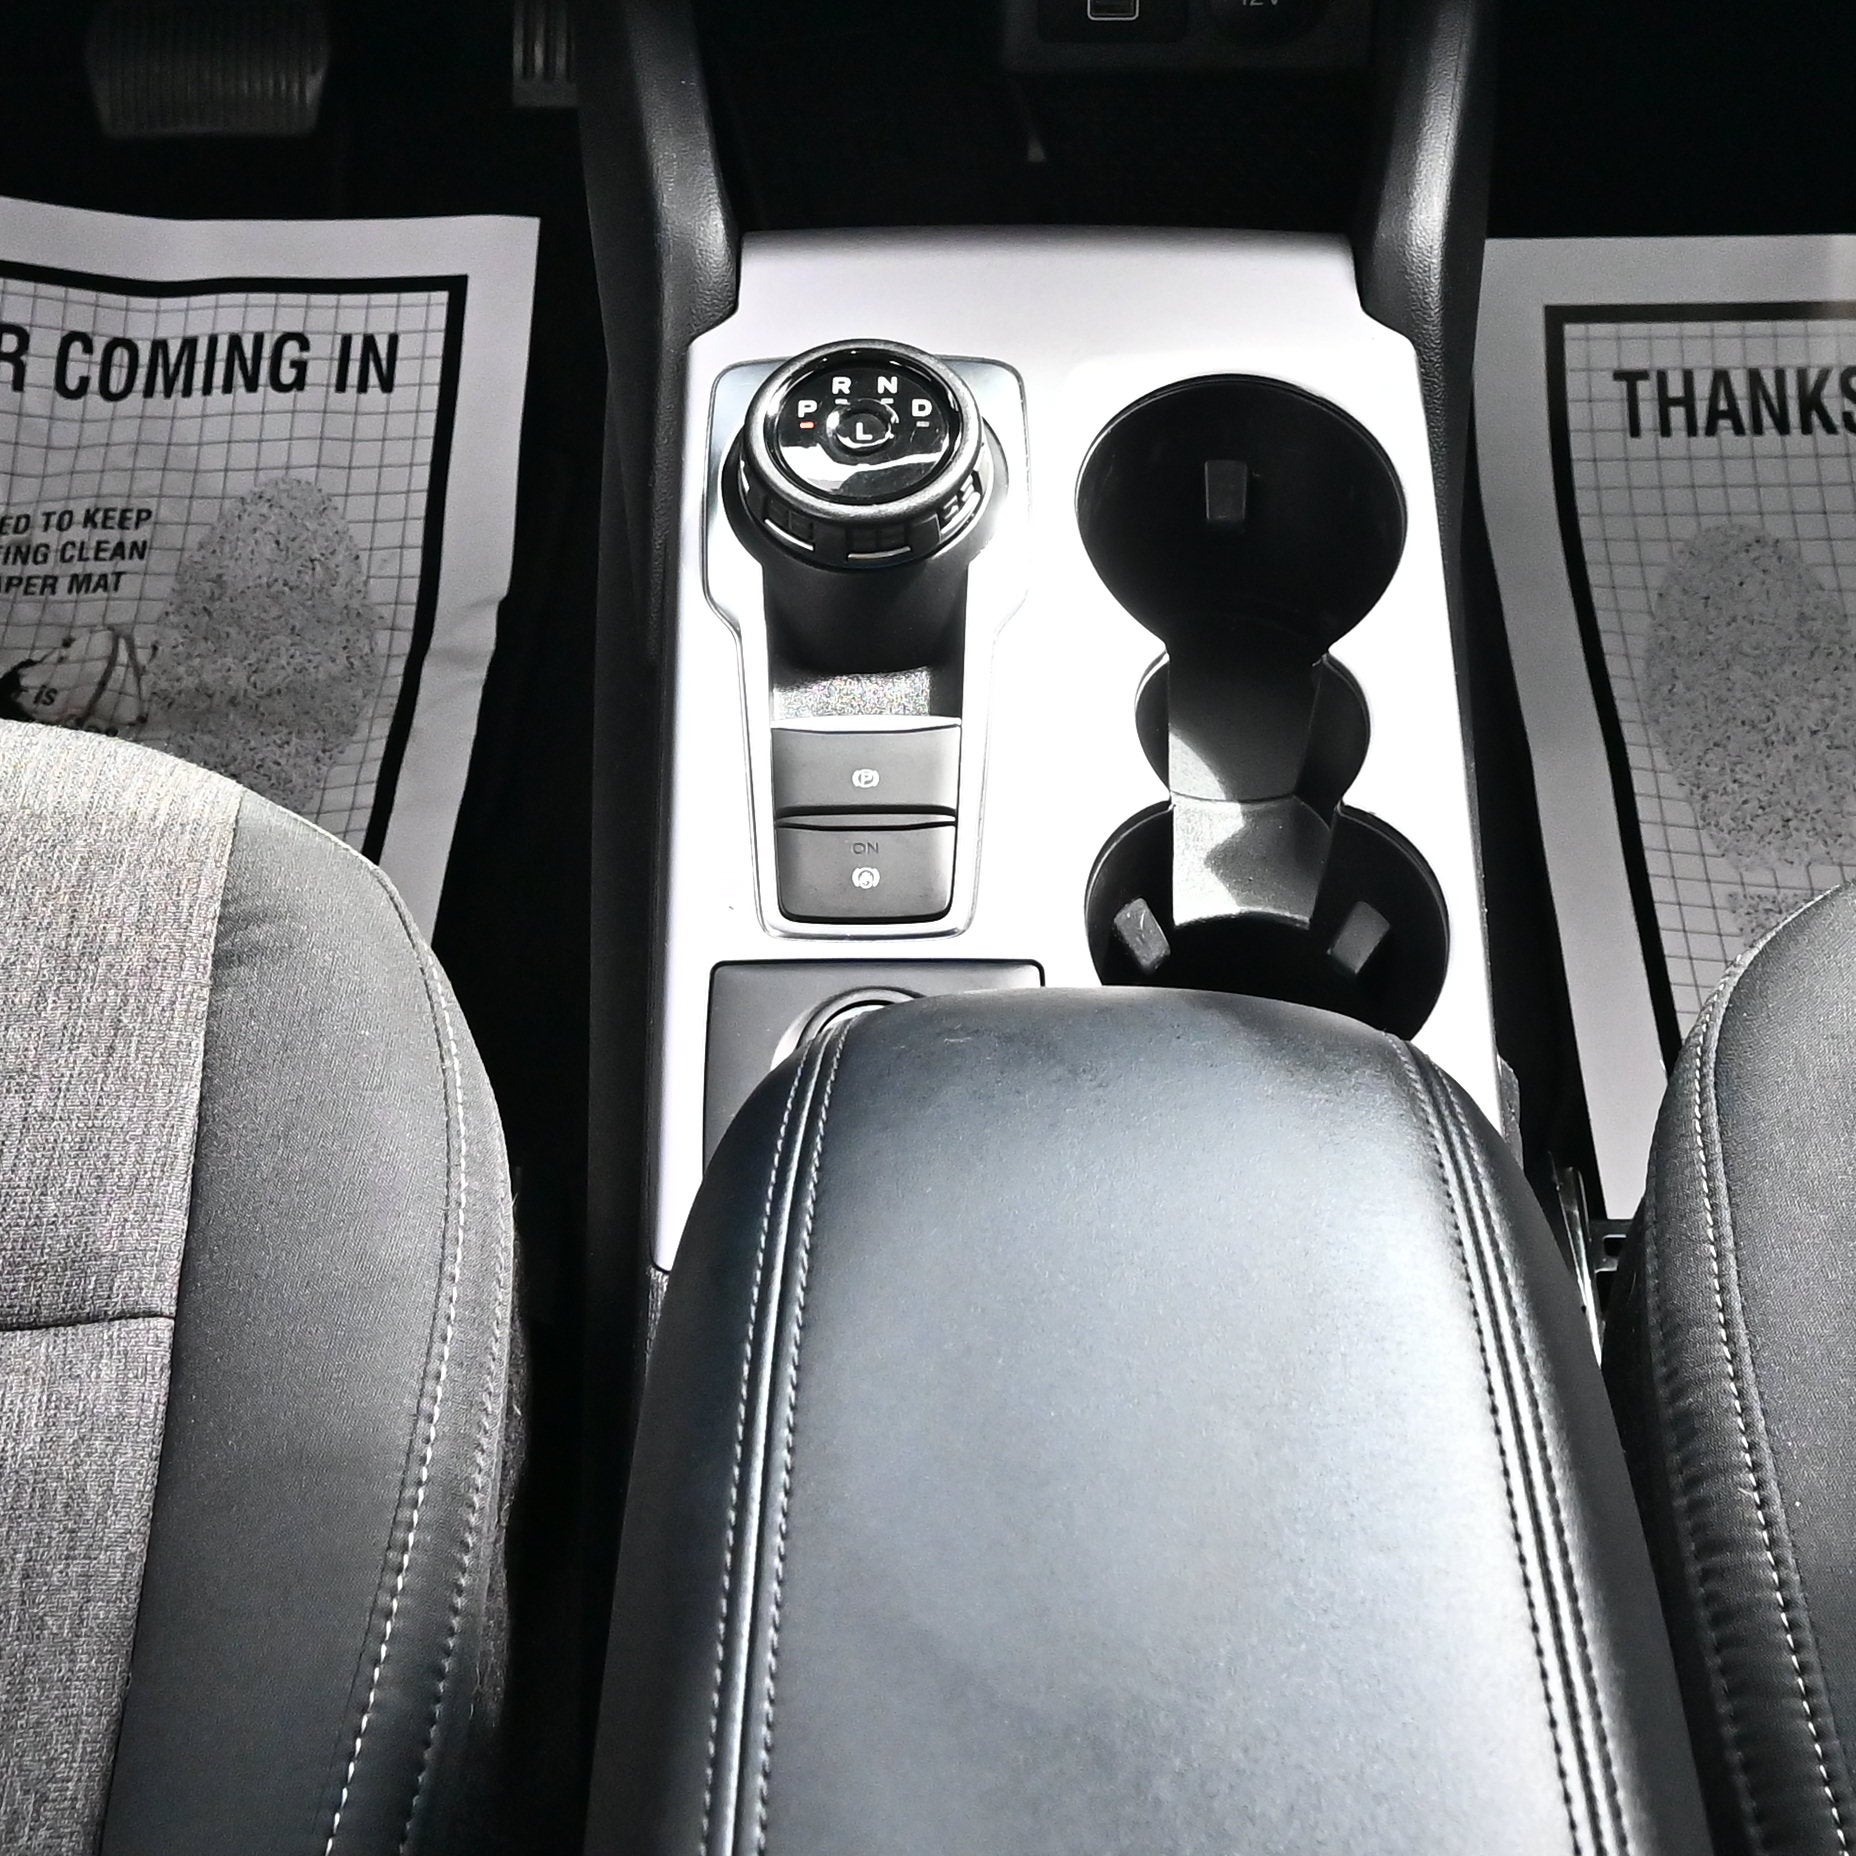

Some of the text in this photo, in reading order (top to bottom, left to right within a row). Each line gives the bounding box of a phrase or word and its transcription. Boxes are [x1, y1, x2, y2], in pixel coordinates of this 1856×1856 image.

[54, 328, 311, 404] COMING
[333, 332, 401, 395] IN
[831, 375, 852, 395] R
[877, 375, 898, 394] N
[797, 399, 818, 418] P
[911, 398, 933, 417] D
[855, 421, 873, 441] L
[41, 508, 74, 533] TO
[81, 507, 153, 532] KEEP
[58, 539, 149, 564] CLEAN
[67, 570, 128, 596] MAT
[852, 842, 880, 855] ON
